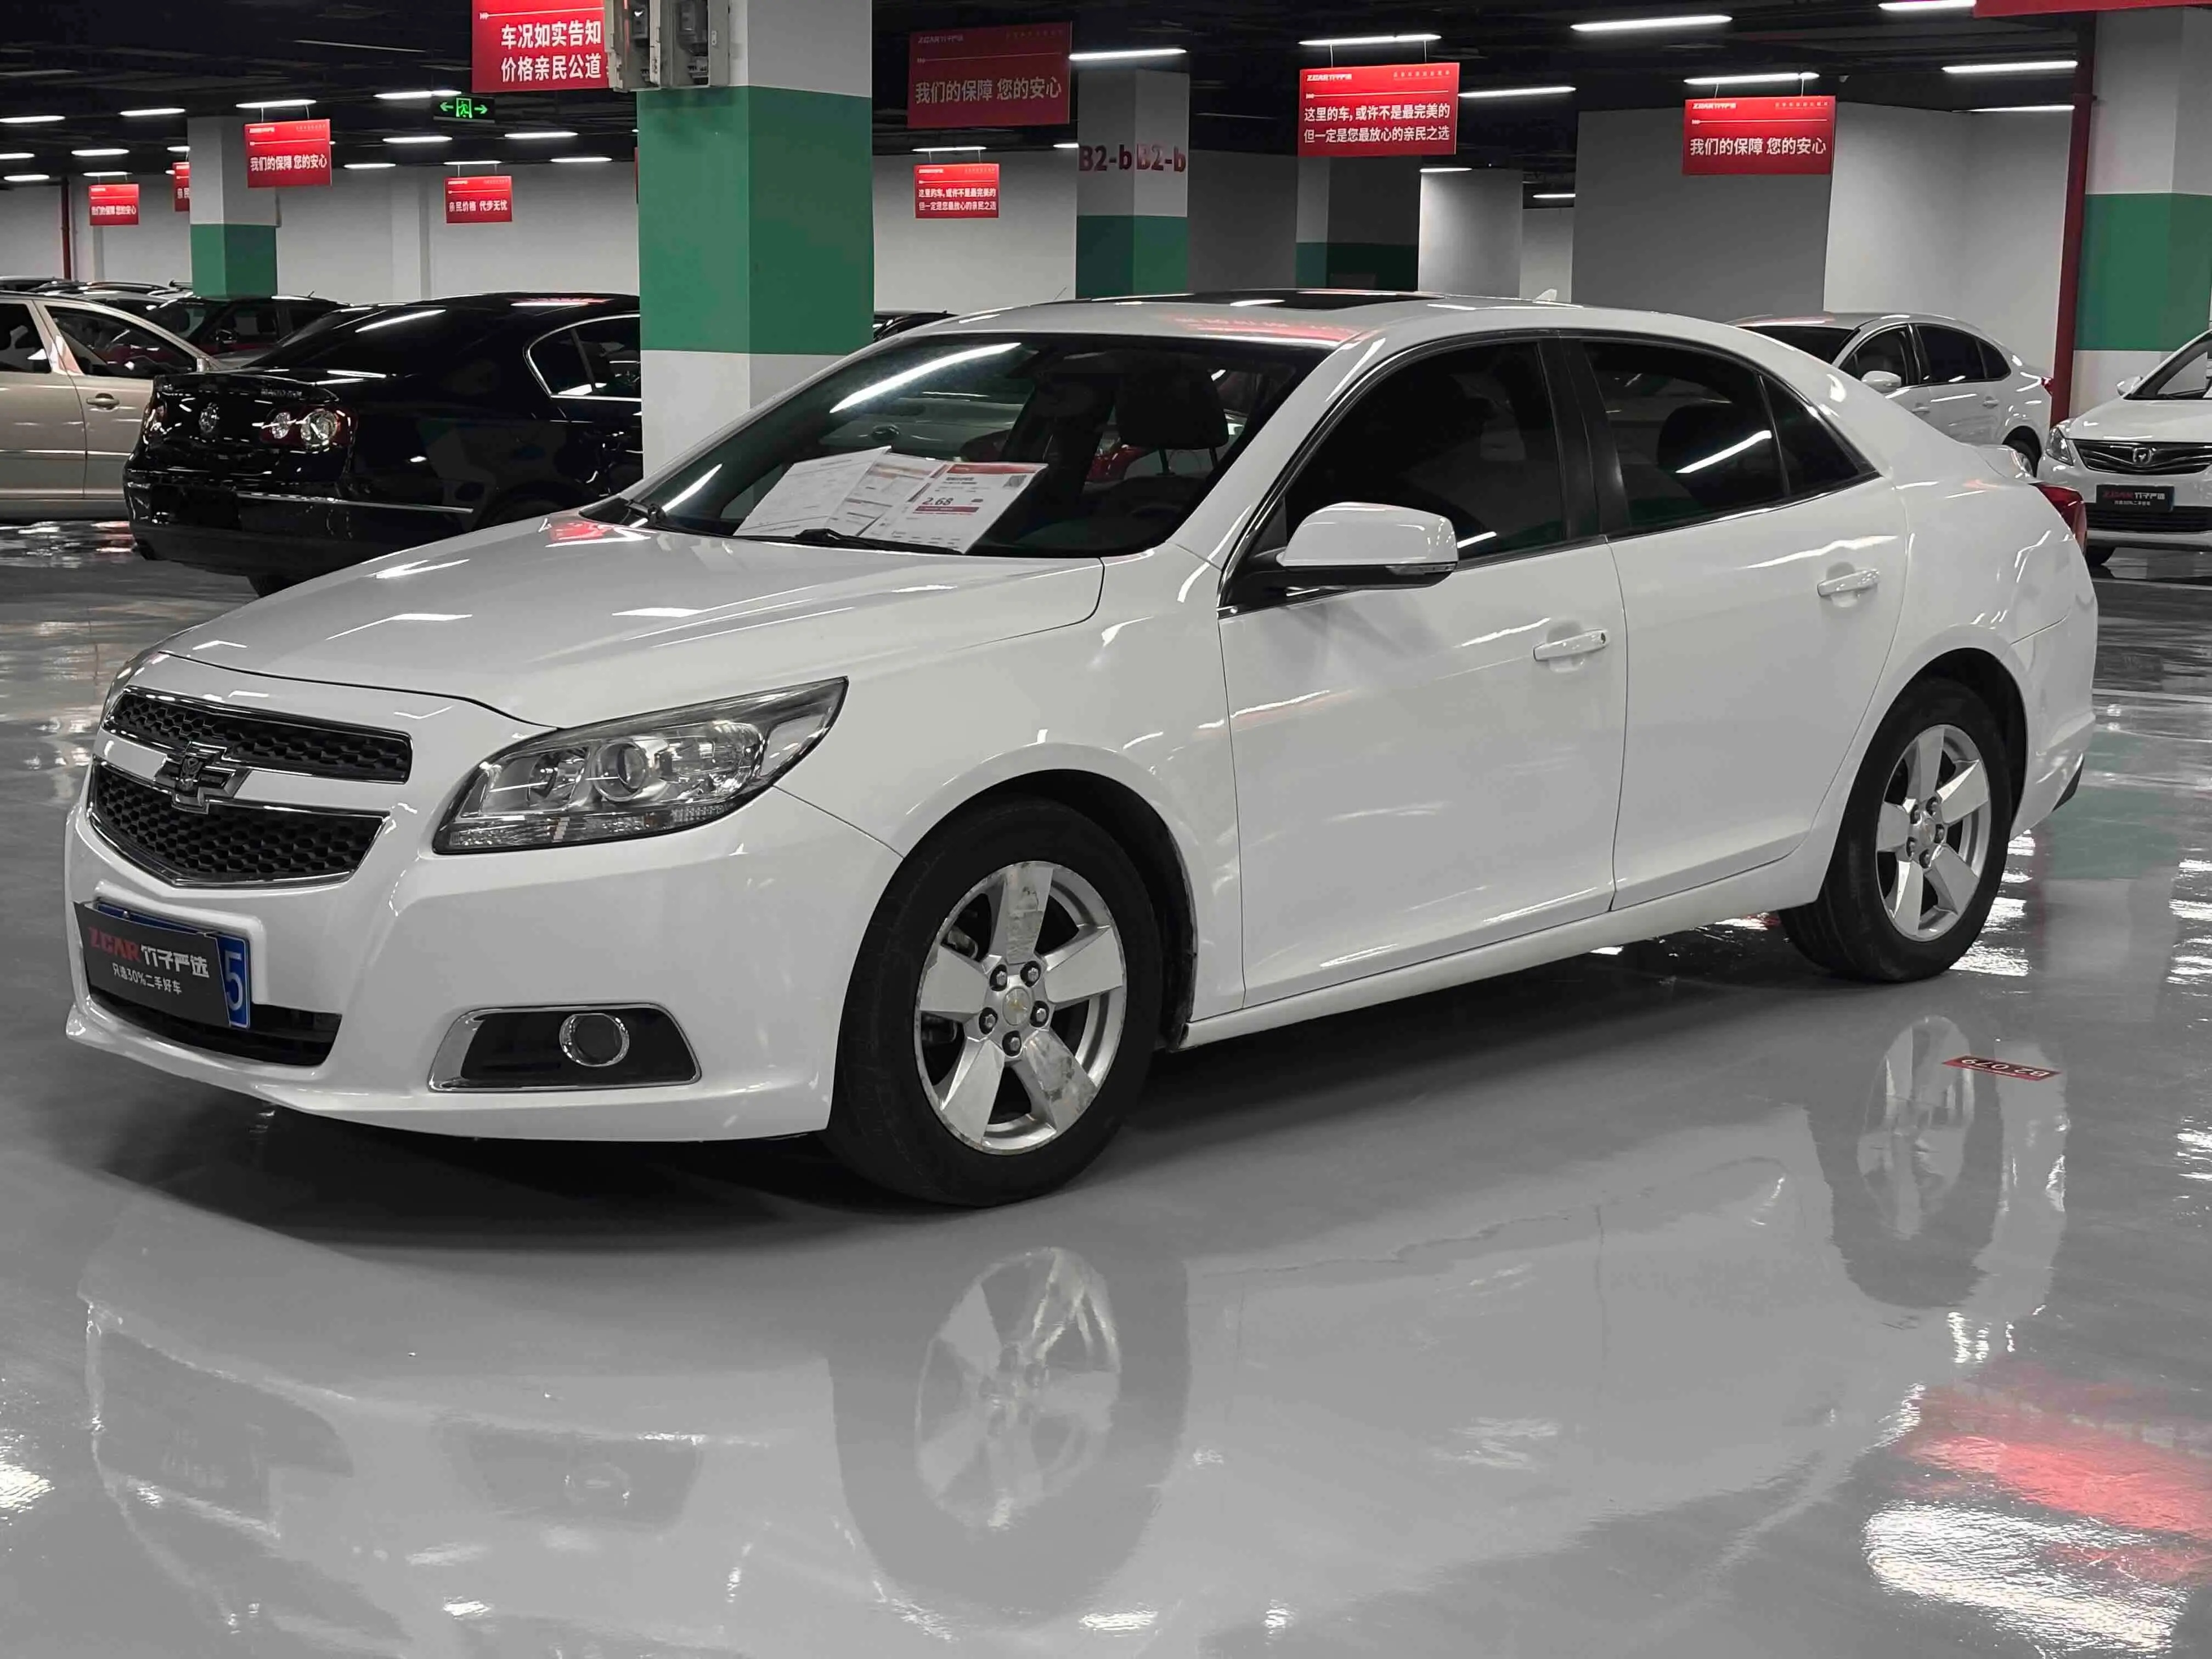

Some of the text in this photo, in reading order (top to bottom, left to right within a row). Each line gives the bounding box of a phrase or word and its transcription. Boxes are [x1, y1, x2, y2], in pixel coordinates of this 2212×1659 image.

[501, 20, 601, 49] 车况如实告知
[501, 53, 602, 83] 价格亲民公道
[915, 76, 1062, 105] 我们的保障 您的安心
[1304, 126, 1450, 143] 但一定是您最放心的亲民之选
[1690, 137, 1826, 156] 我们的保障 您的安心
[250, 153, 328, 172] 我们的保障 您的安心
[1079, 144, 1132, 171] B2-b
[1137, 144, 1186, 172] B2-b
[923, 497, 953, 505] 2.68
[88, 926, 140, 962] ZCAR
[223, 950, 243, 1011] 5
